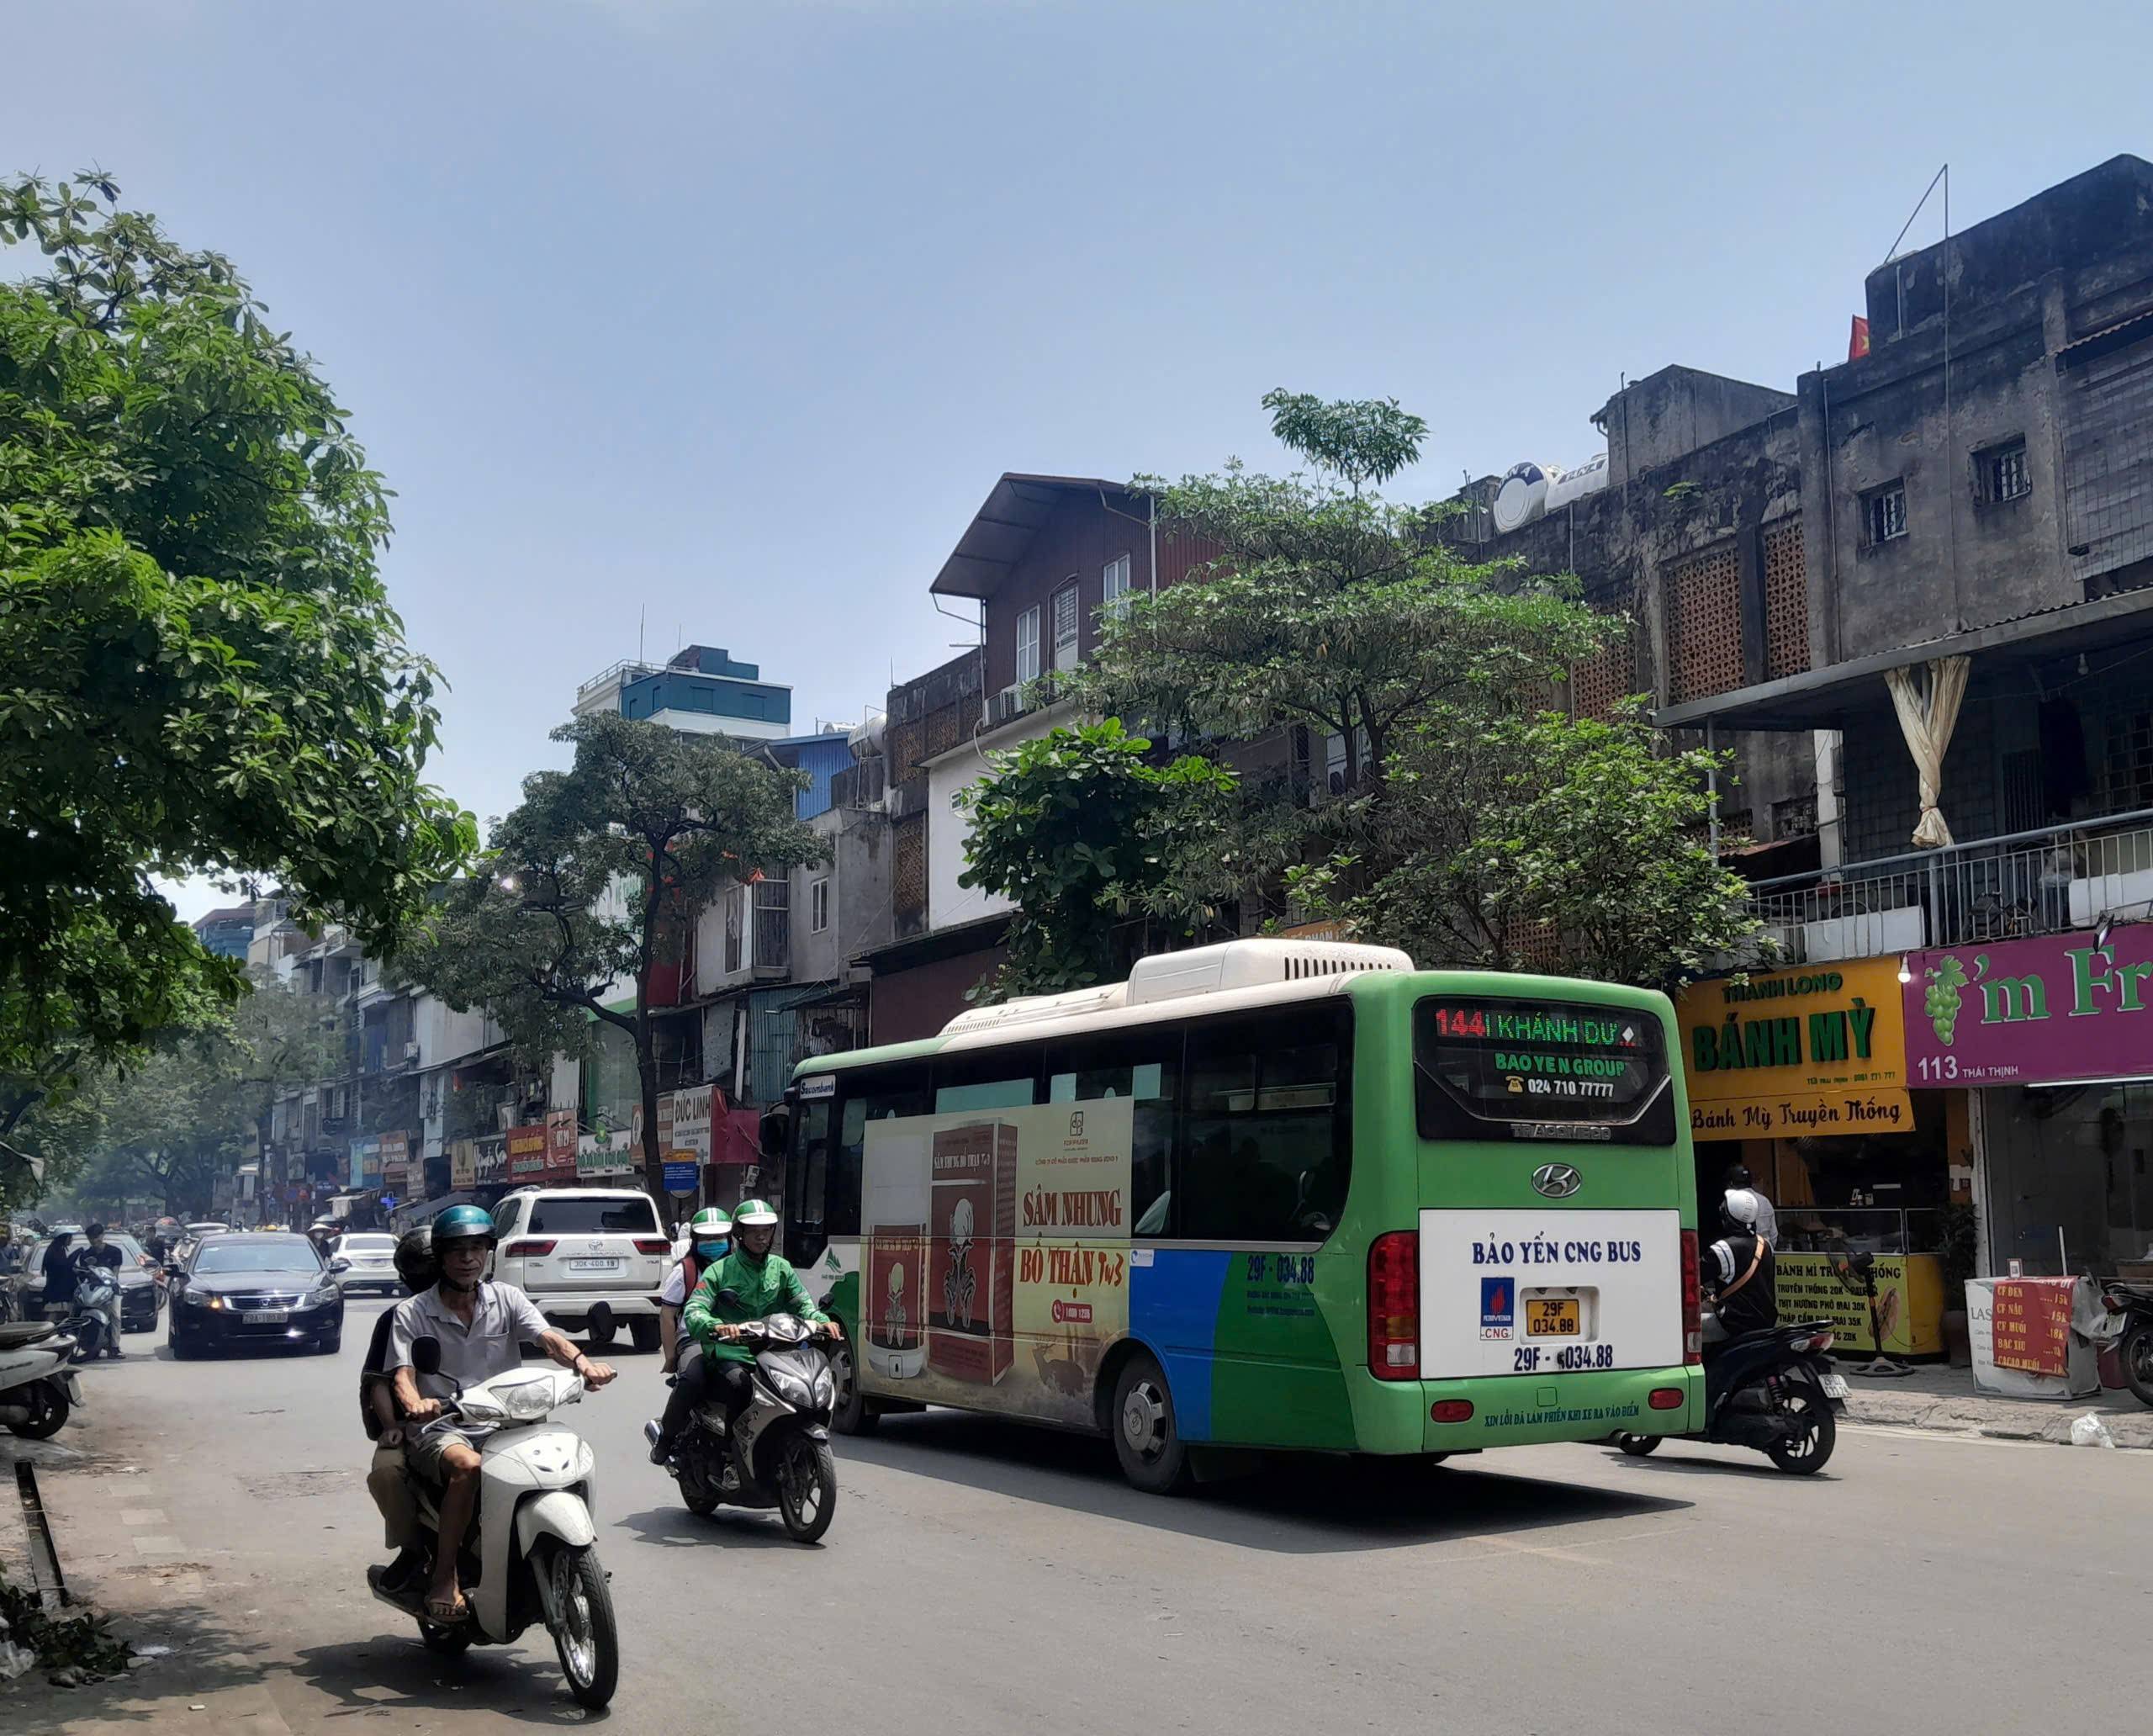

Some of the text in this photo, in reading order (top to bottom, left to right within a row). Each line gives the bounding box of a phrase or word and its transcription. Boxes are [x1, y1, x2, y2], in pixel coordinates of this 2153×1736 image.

[1722, 972, 1844, 1003] THANH LONG
[1436, 1008, 1485, 1035] 144
[1498, 1011, 1578, 1042] KHÁNH
[1692, 997, 1875, 1072] BÁNH MỲ
[1495, 1052, 1531, 1072] BAO
[1573, 1058, 1625, 1077] GROUP
[1918, 1056, 2018, 1080] 113 THÁI THỊNH
[1527, 1078, 1614, 1097] 024 710 77777
[693, 1095, 711, 1121] LINH
[1691, 1096, 1902, 1130] Bánh Mỳ Truyền Thống
[1024, 1183, 1122, 1227] SÂM NHUNG
[1472, 1231, 1641, 1264] BẢO YẾN CNG BUS
[1019, 1231, 1044, 1283] BỔ
[1048, 1241, 1095, 1299] THẬN
[1277, 1255, 1315, 1284] 034.88
[1776, 1262, 1803, 1277] BÁNH
[1807, 1263, 1817, 1277] MÌ
[1997, 1286, 2007, 1297] CF
[1542, 1302, 1564, 1316] 29F
[1997, 1304, 2006, 1315] CF
[1485, 1328, 1509, 1338] CNG
[1533, 1318, 1574, 1333] 034.88
[1997, 1321, 2006, 1331] CF
[1514, 1347, 1541, 1372] 29F
[1565, 1344, 1613, 1369] 034.88
[1484, 1415, 1498, 1427] XIN
